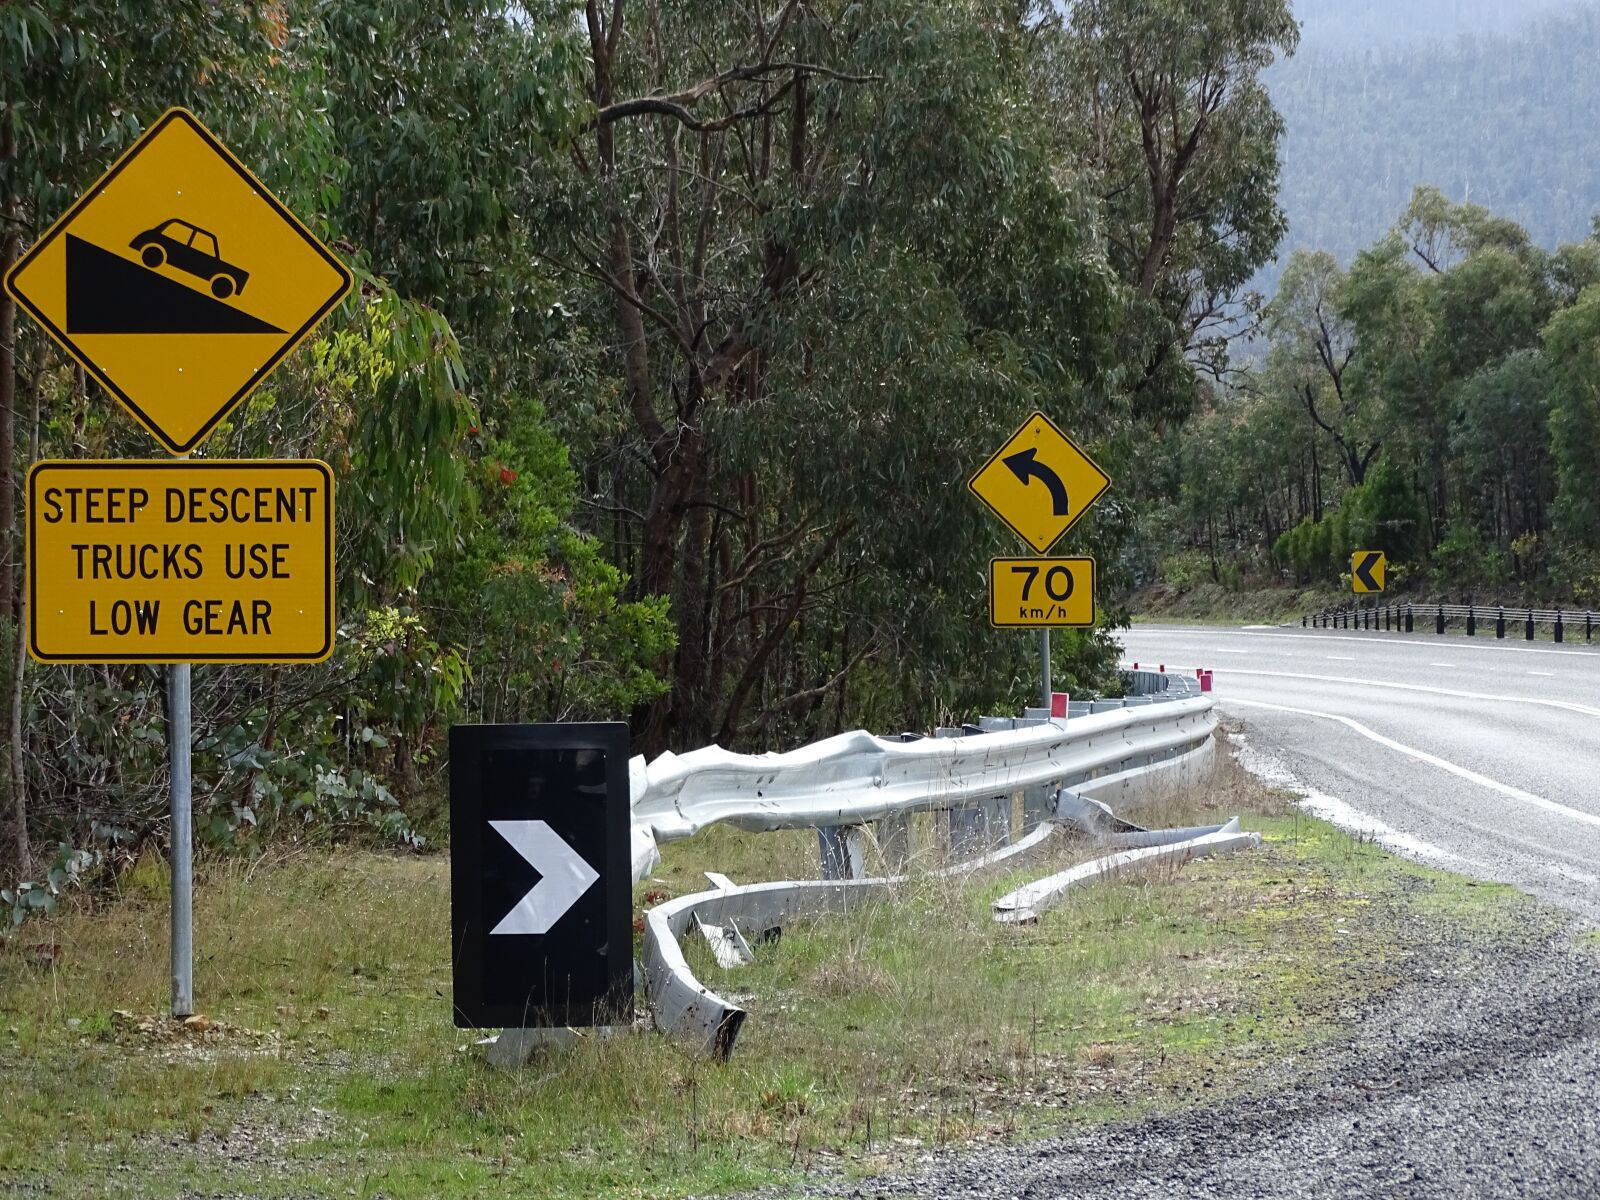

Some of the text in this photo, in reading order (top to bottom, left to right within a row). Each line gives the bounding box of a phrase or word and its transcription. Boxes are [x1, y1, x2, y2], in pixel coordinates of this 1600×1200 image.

[43, 487, 317, 523] STEEP DESCENT
[71, 544, 290, 580] TRUCKS USE
[1011, 565, 1074, 602] 70
[89, 599, 272, 636] LOW GEAR
[1019, 604, 1067, 619] km/h
